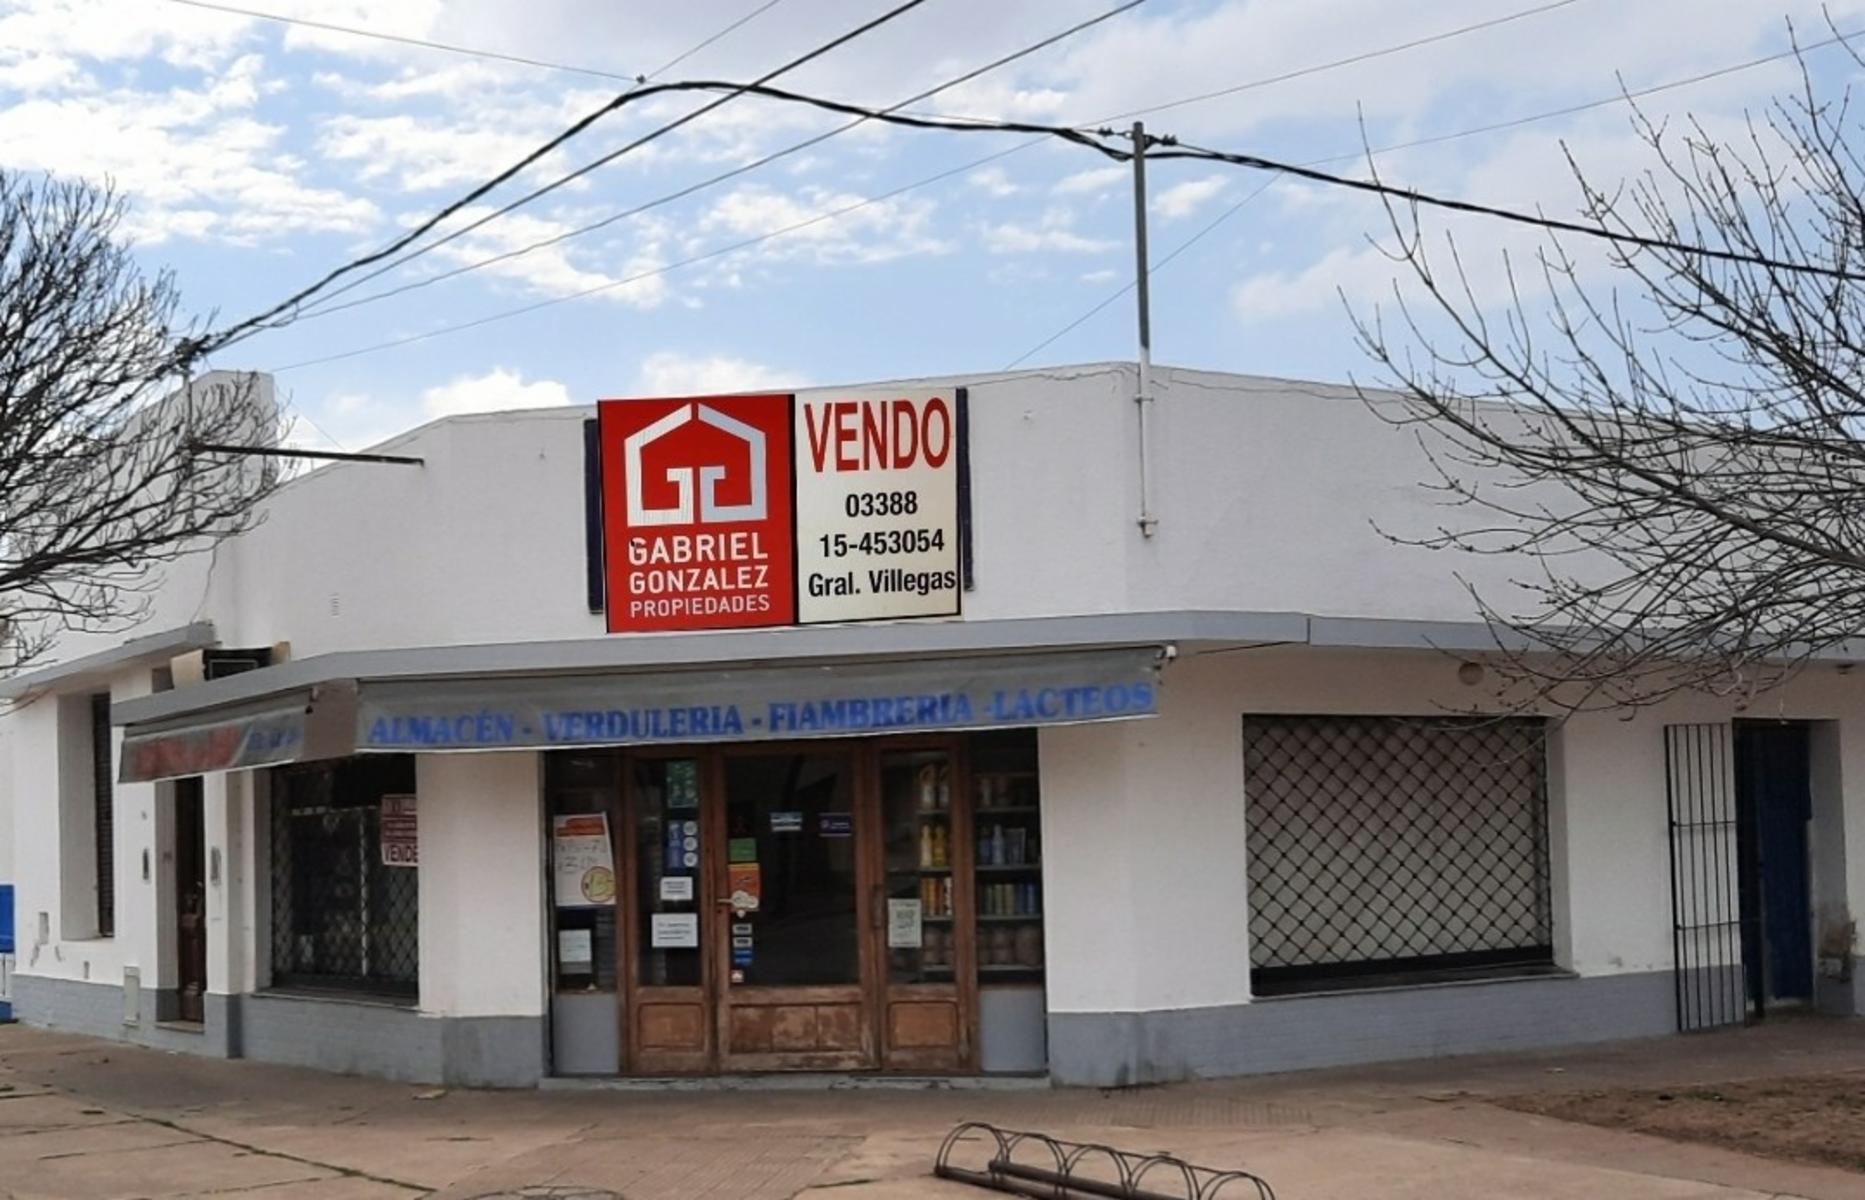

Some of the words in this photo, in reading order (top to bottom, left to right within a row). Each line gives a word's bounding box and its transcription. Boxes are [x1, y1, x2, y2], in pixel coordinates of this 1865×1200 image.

[804, 397, 950, 473] VENDO
[845, 491, 918, 517] 03388
[628, 532, 768, 565] GABRIEL
[819, 529, 944, 557] 15-453054
[630, 565, 768, 594] GONZALEZ
[808, 571, 860, 597] Gral.
[869, 568, 956, 598] Villegas
[630, 594, 770, 618] PROPIEDADES
[367, 709, 514, 744] ALMACÉN
[542, 704, 743, 741] VERDULERIA
[769, 692, 974, 732] FIAMBRERIA
